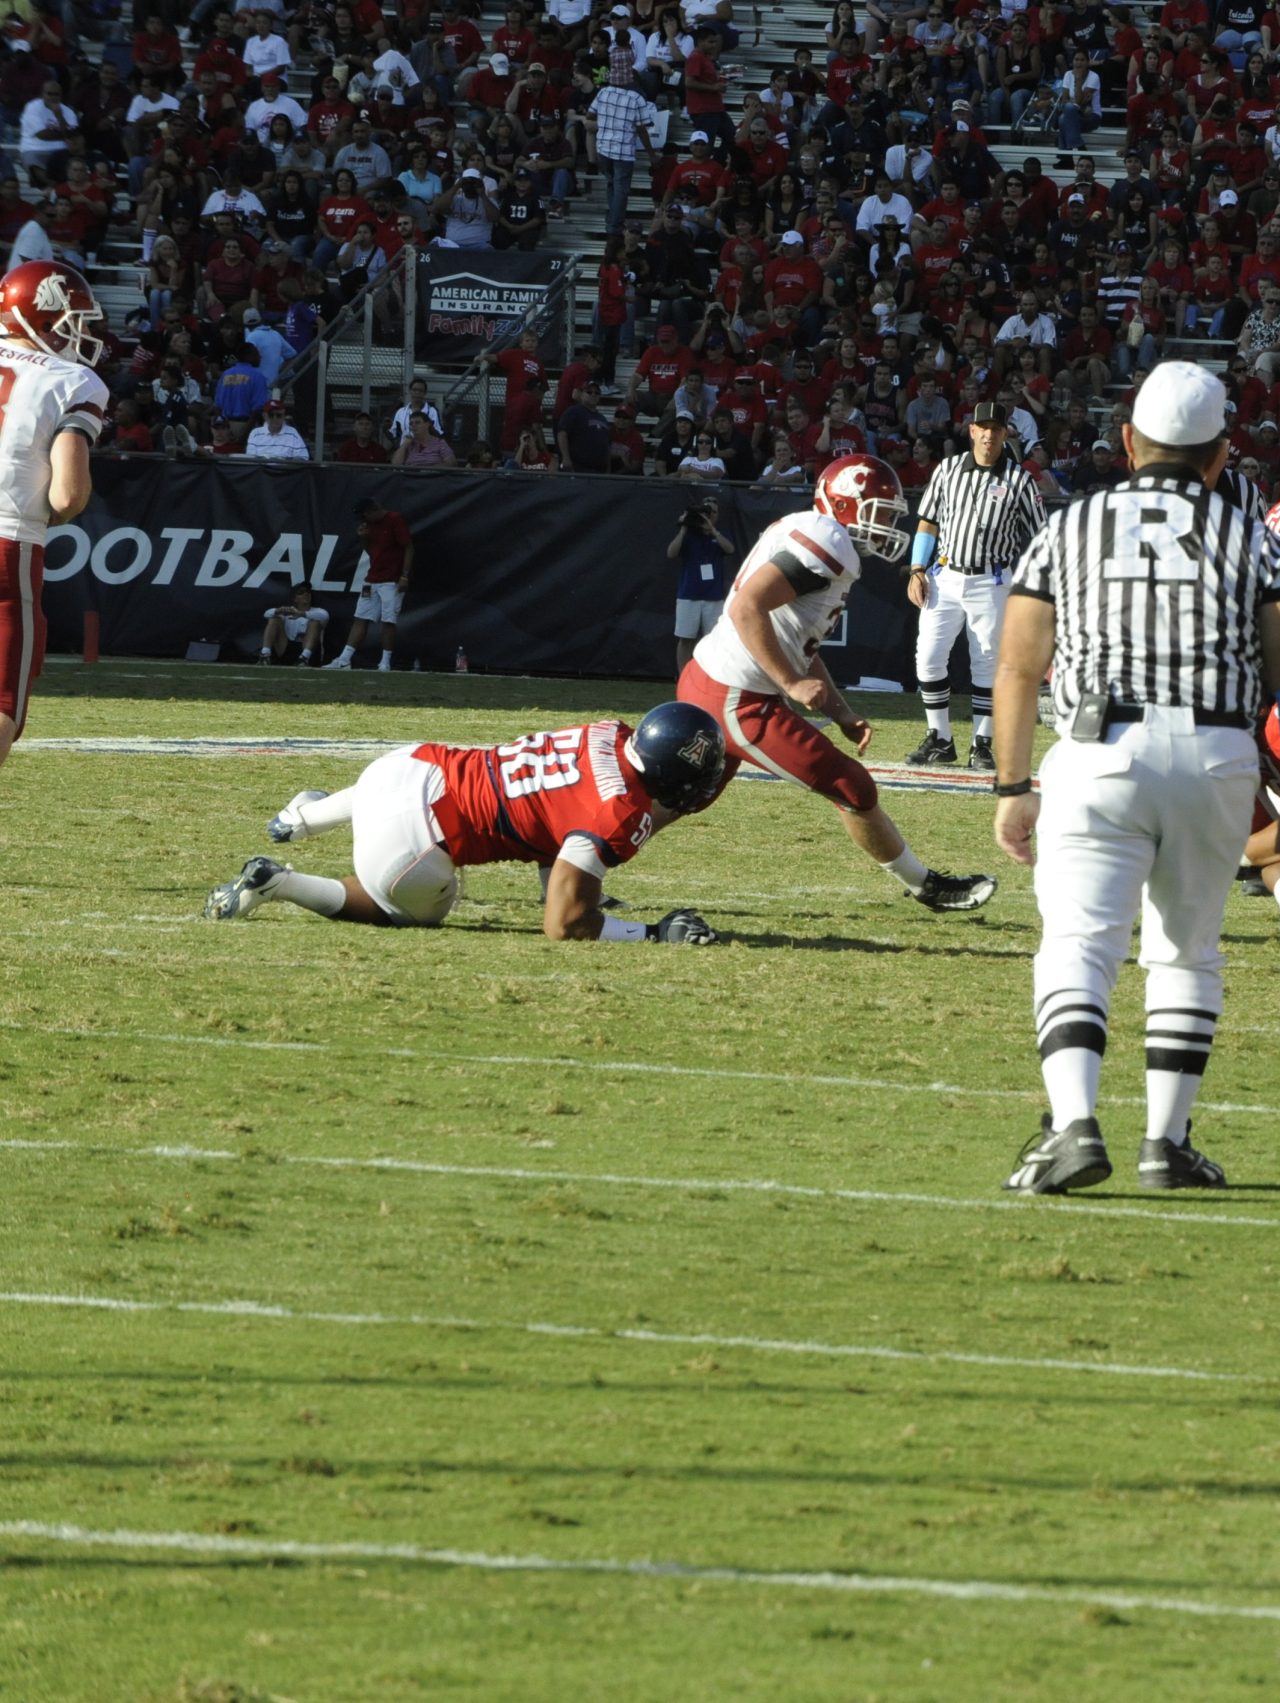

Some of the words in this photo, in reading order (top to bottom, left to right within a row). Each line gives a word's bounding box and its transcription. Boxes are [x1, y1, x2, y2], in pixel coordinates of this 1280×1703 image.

[510, 204, 527, 219] 10
[420, 252, 431, 263] 26
[551, 260, 561, 270] 27
[431, 286, 498, 300] AMERICAN
[503, 290, 550, 304] FAMIY
[440, 301, 528, 313] INSURANC
[0, 346, 49, 367] ESTAEL
[1103, 492, 1199, 581] R
[43, 524, 371, 593] OOTBAL
[630, 812, 652, 850] 5
